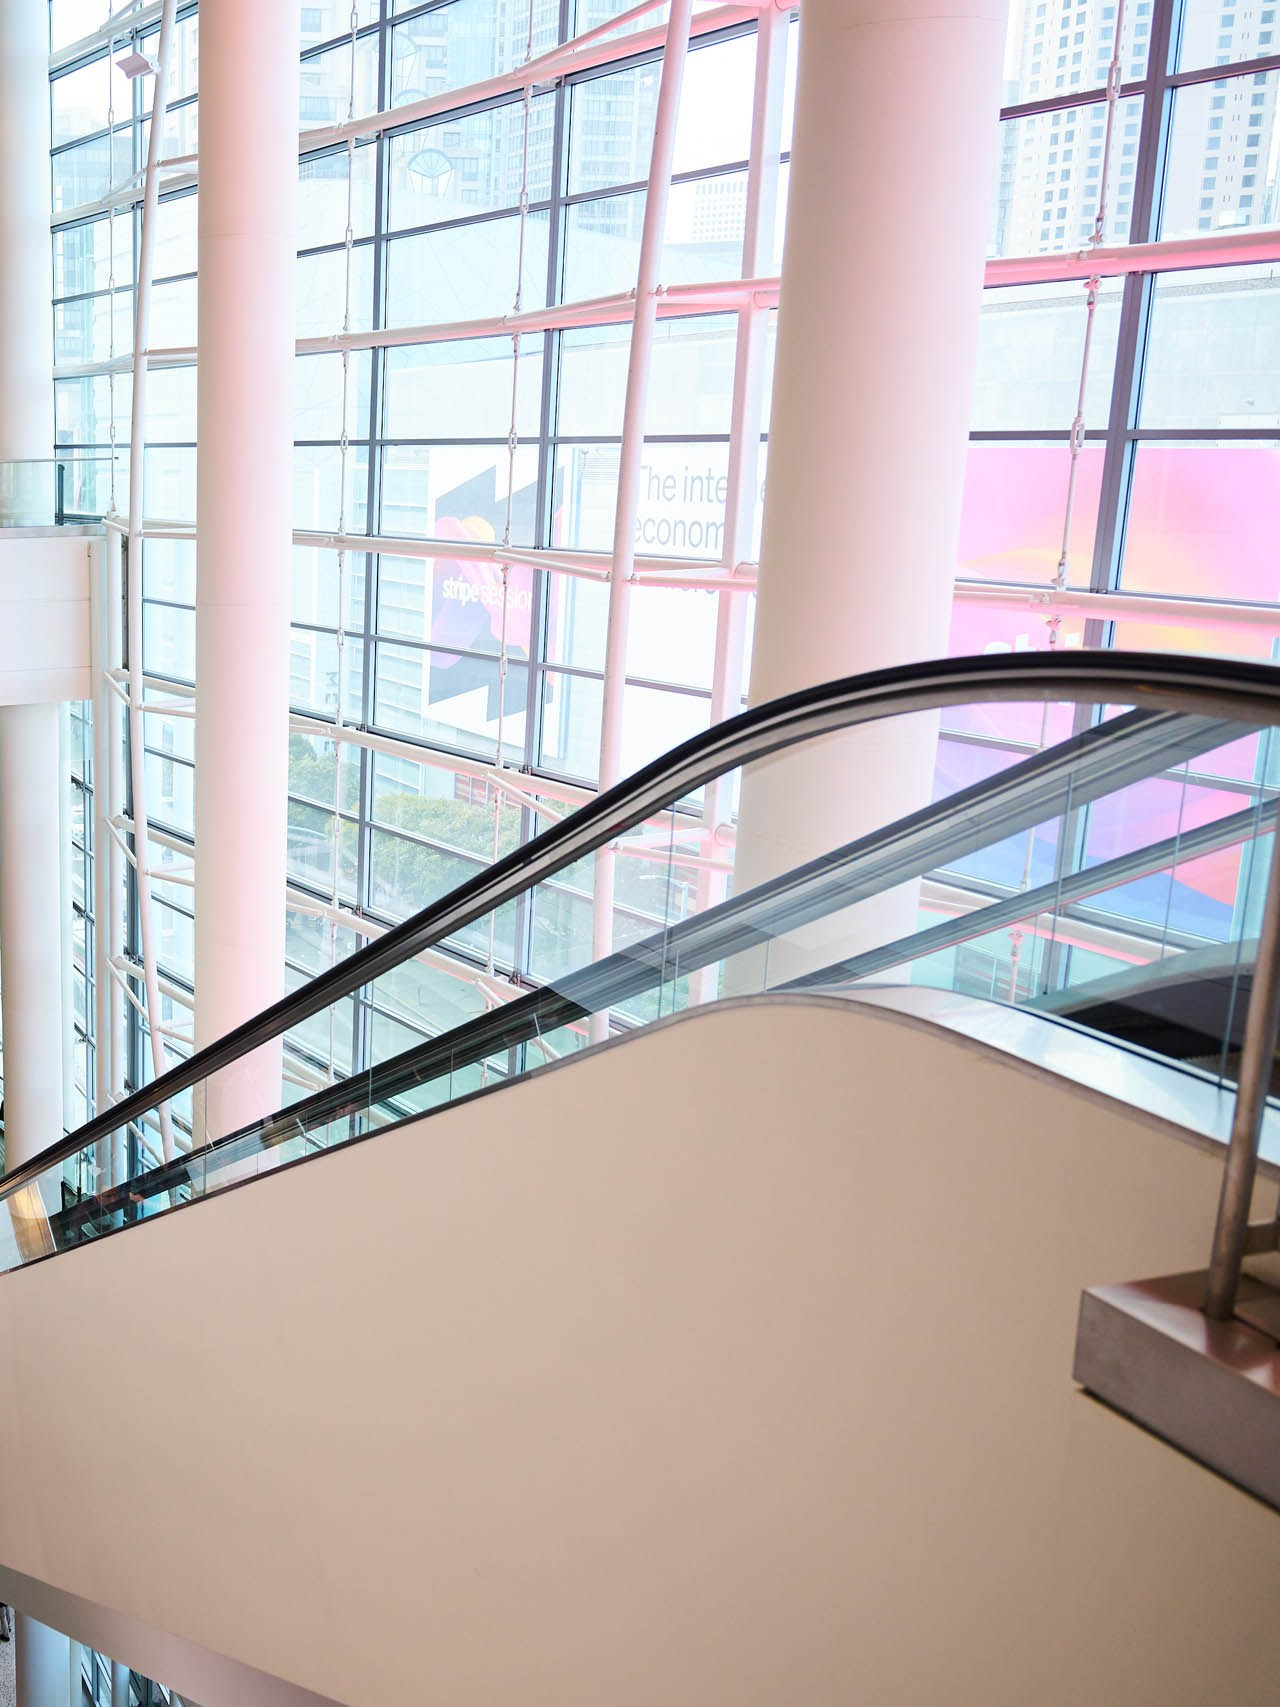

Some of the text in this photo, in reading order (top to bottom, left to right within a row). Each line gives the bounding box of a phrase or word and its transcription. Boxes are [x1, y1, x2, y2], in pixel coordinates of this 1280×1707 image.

[640, 464, 676, 502] he
[633, 517, 724, 550] econom
[442, 576, 479, 606] stripe
